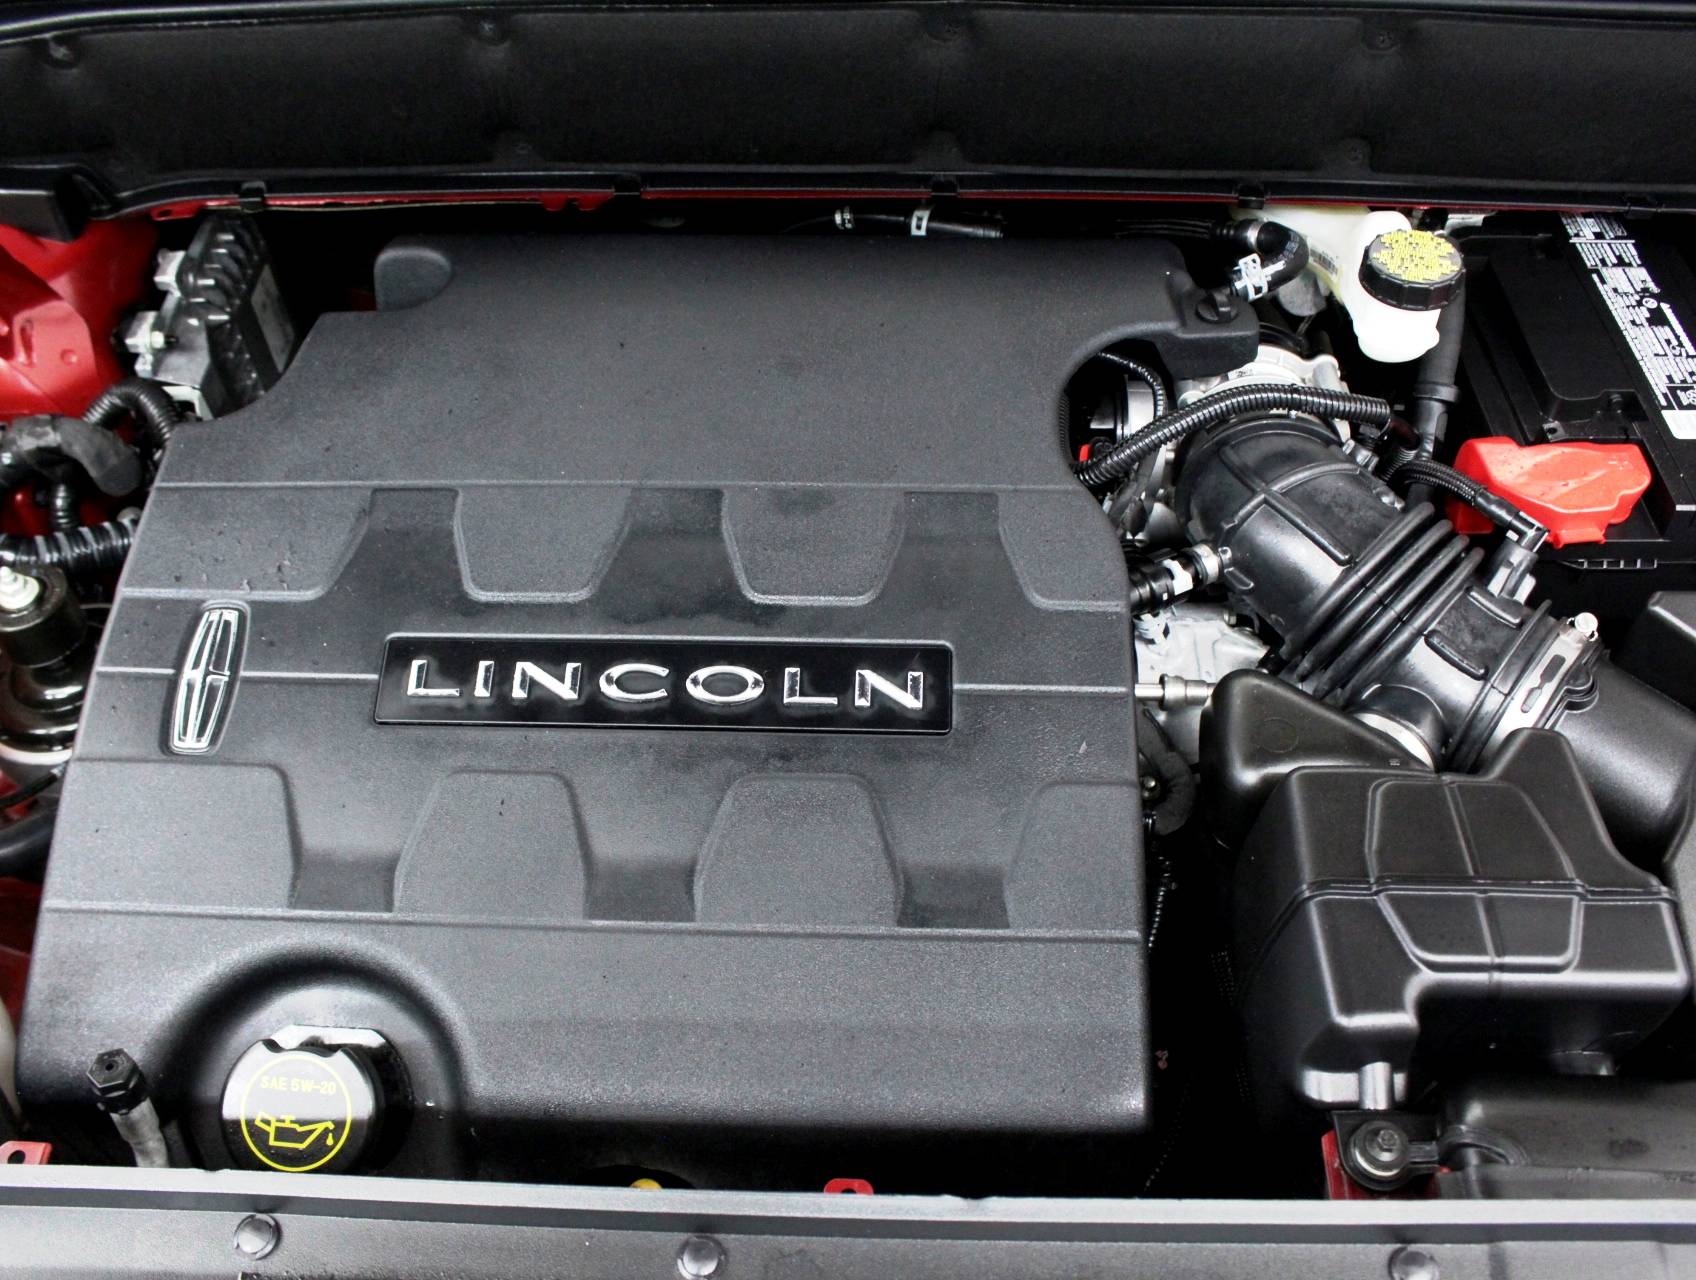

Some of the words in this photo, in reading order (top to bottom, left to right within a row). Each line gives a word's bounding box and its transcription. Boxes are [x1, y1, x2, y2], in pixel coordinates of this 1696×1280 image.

[406, 658, 924, 710] LINCOLN
[261, 1075, 288, 1091] SAE
[291, 1077, 336, 1095] 5W-20
